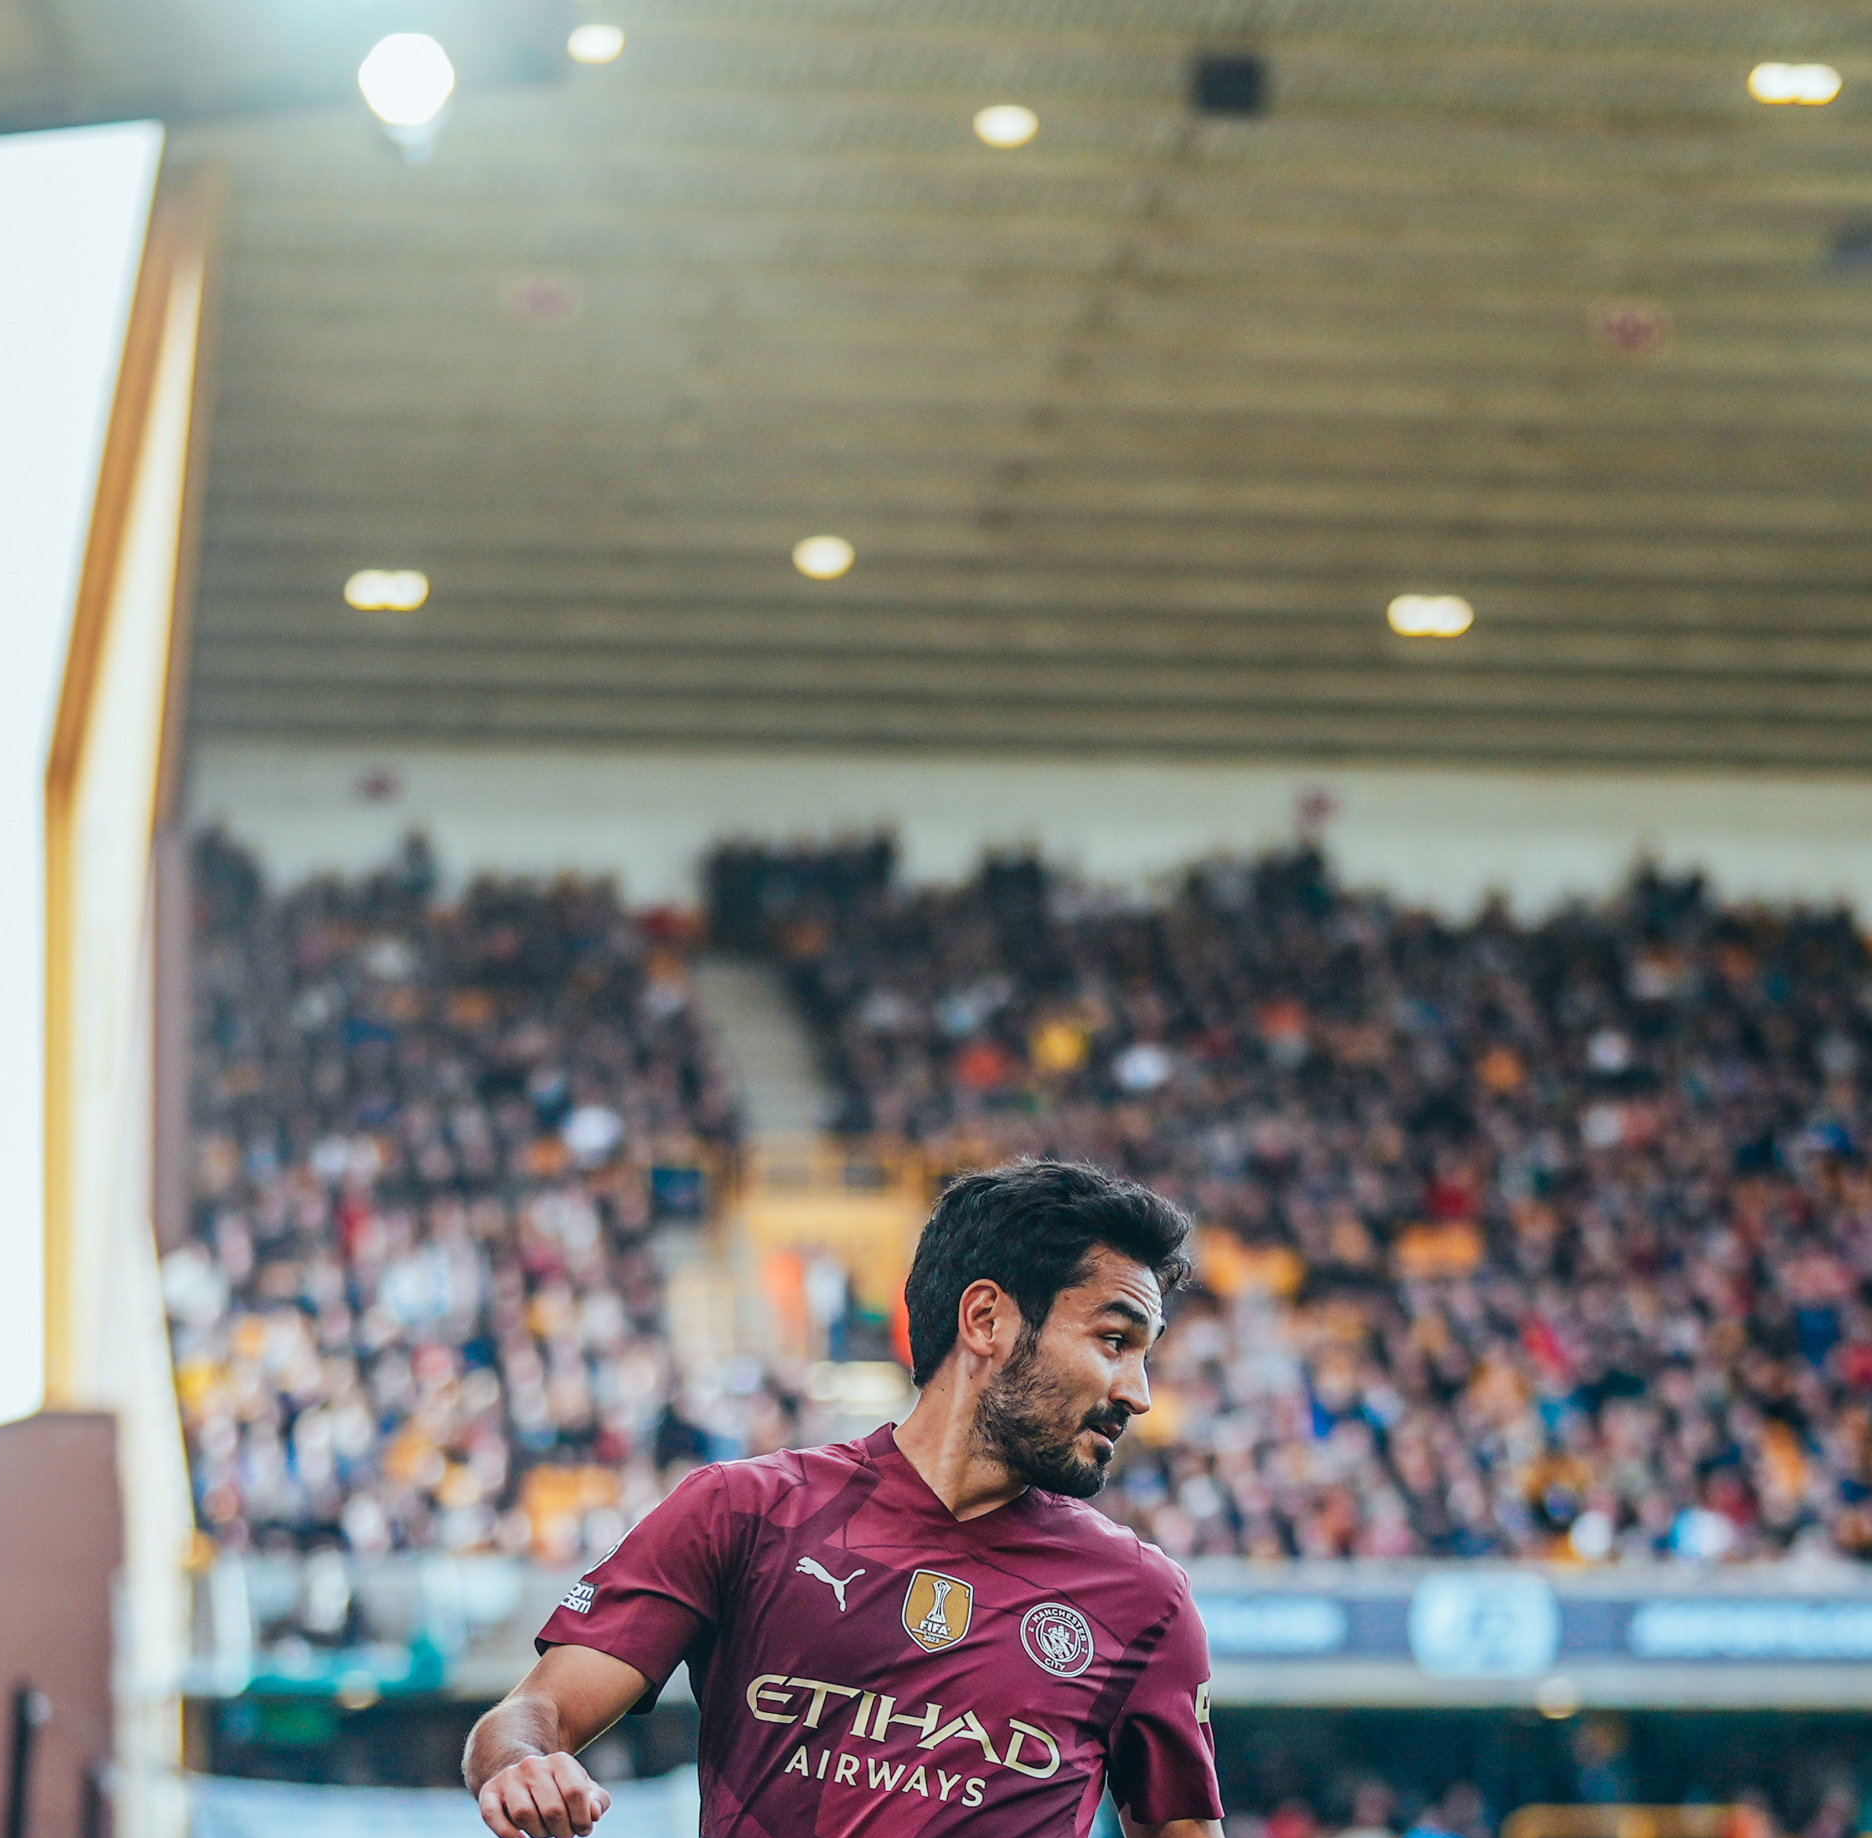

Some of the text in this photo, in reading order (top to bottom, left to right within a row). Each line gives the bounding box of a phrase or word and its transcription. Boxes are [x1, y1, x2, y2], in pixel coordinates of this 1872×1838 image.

[919, 1620, 949, 1636] FIFA
[1031, 1608, 1087, 1642] MANCHESTER
[1044, 1658, 1066, 1671] CITY
[746, 1673, 1061, 1779] ETIHAD
[784, 1745, 986, 1807] AIRWAYS
